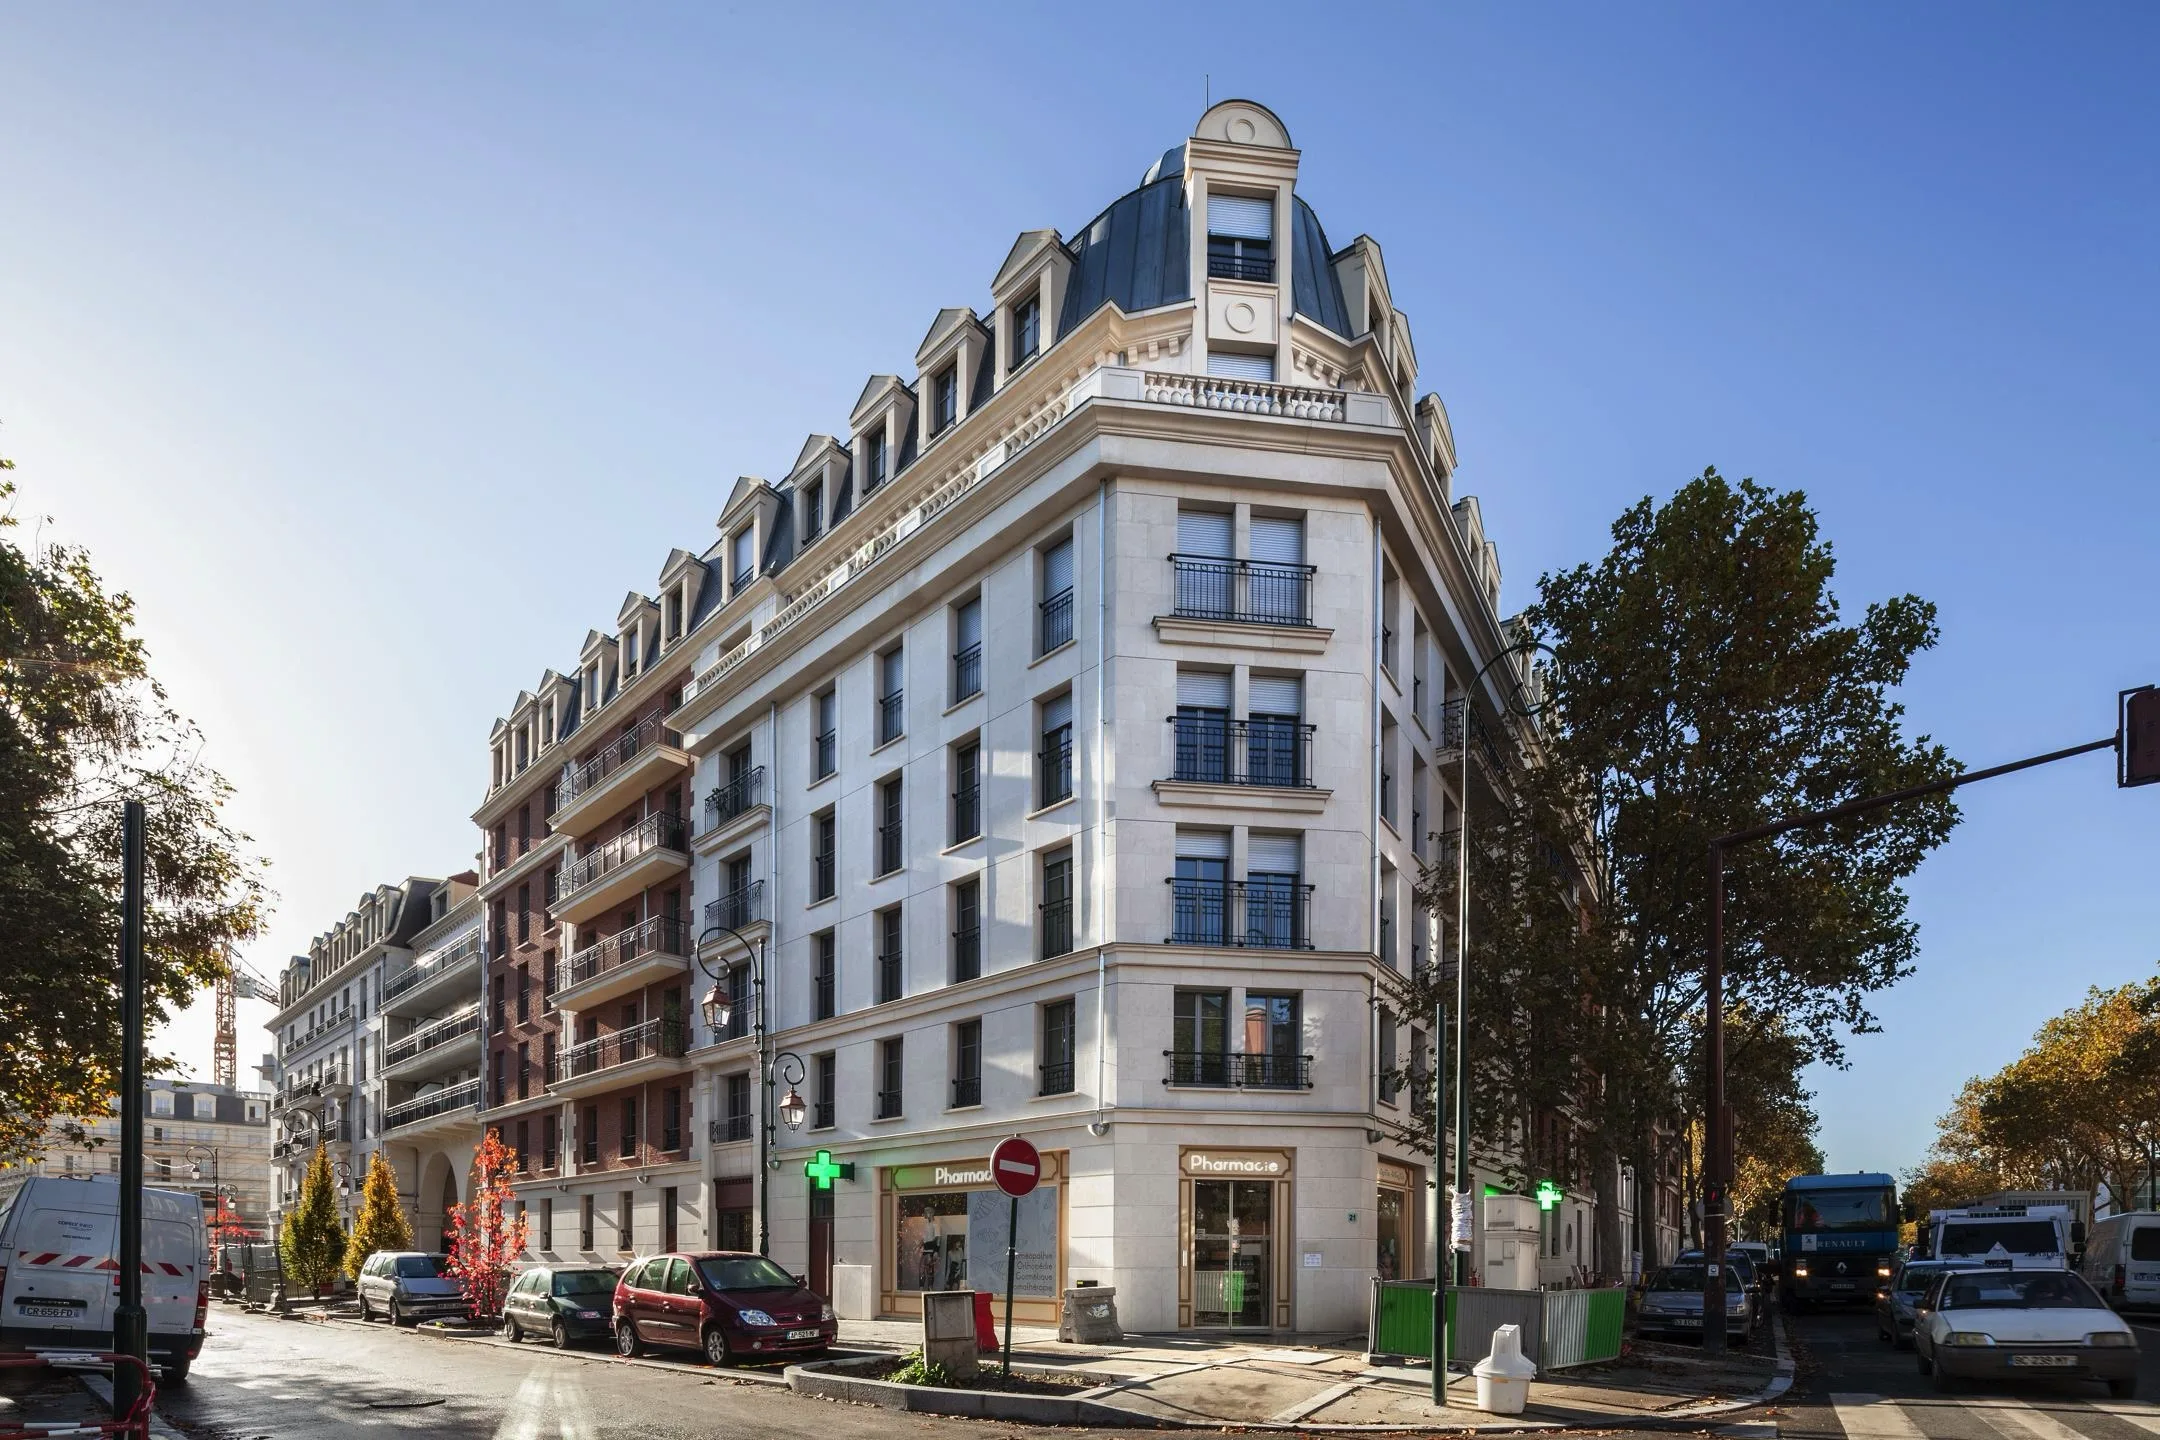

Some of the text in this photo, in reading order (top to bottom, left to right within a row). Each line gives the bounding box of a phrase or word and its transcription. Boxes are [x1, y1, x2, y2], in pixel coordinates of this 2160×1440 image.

[1190, 1154, 1279, 1172] Pharmacie
[935, 1167, 994, 1185] Pharmac
[1817, 1240, 1866, 1249] RENAULT
